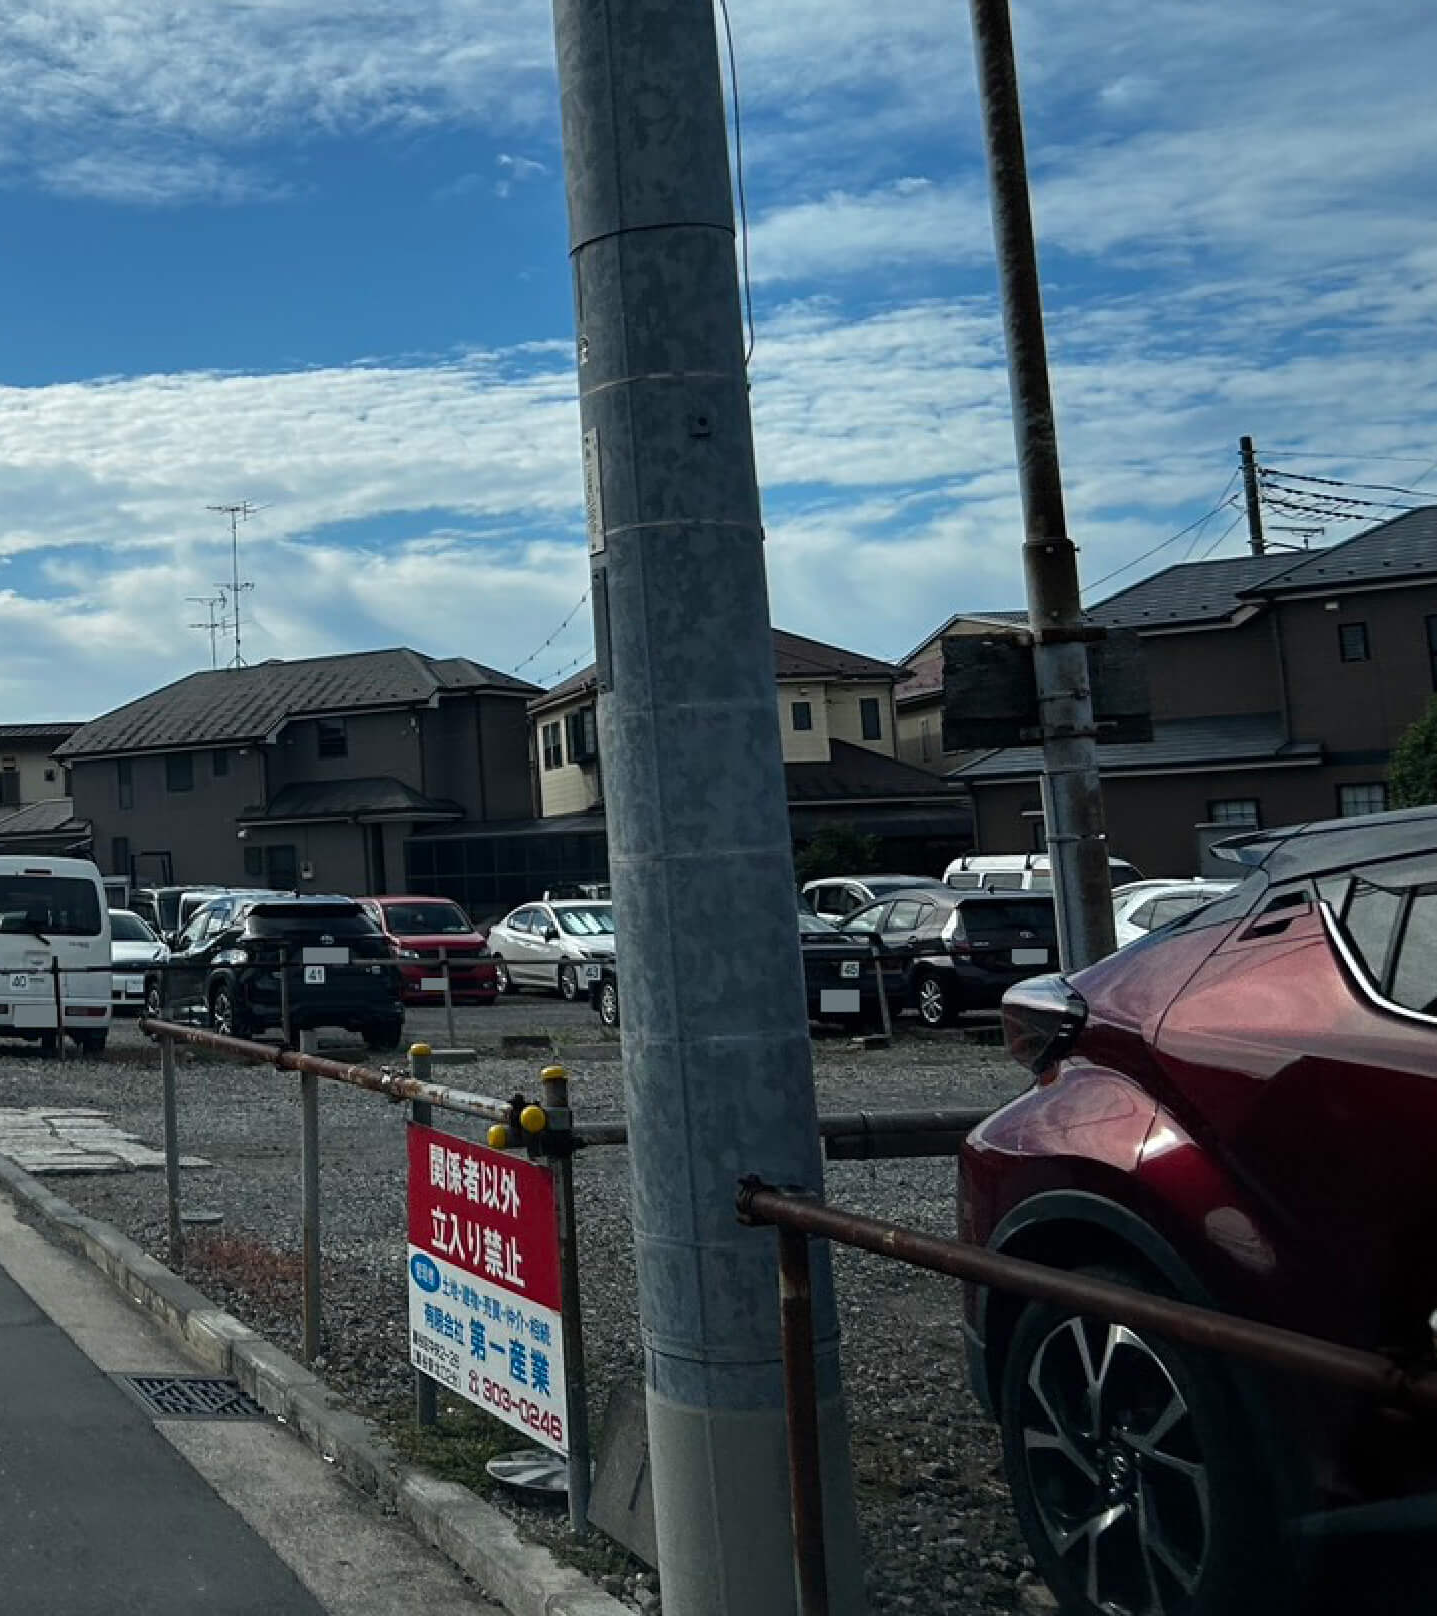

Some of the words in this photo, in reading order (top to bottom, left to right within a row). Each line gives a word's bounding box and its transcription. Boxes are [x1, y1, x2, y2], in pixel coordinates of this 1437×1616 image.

[428, 1142, 519, 1218] 関係者以外
[430, 1205, 526, 1289] 立入り禁止
[424, 1302, 465, 1346] 有限会社
[469, 1317, 551, 1397] 第一産業
